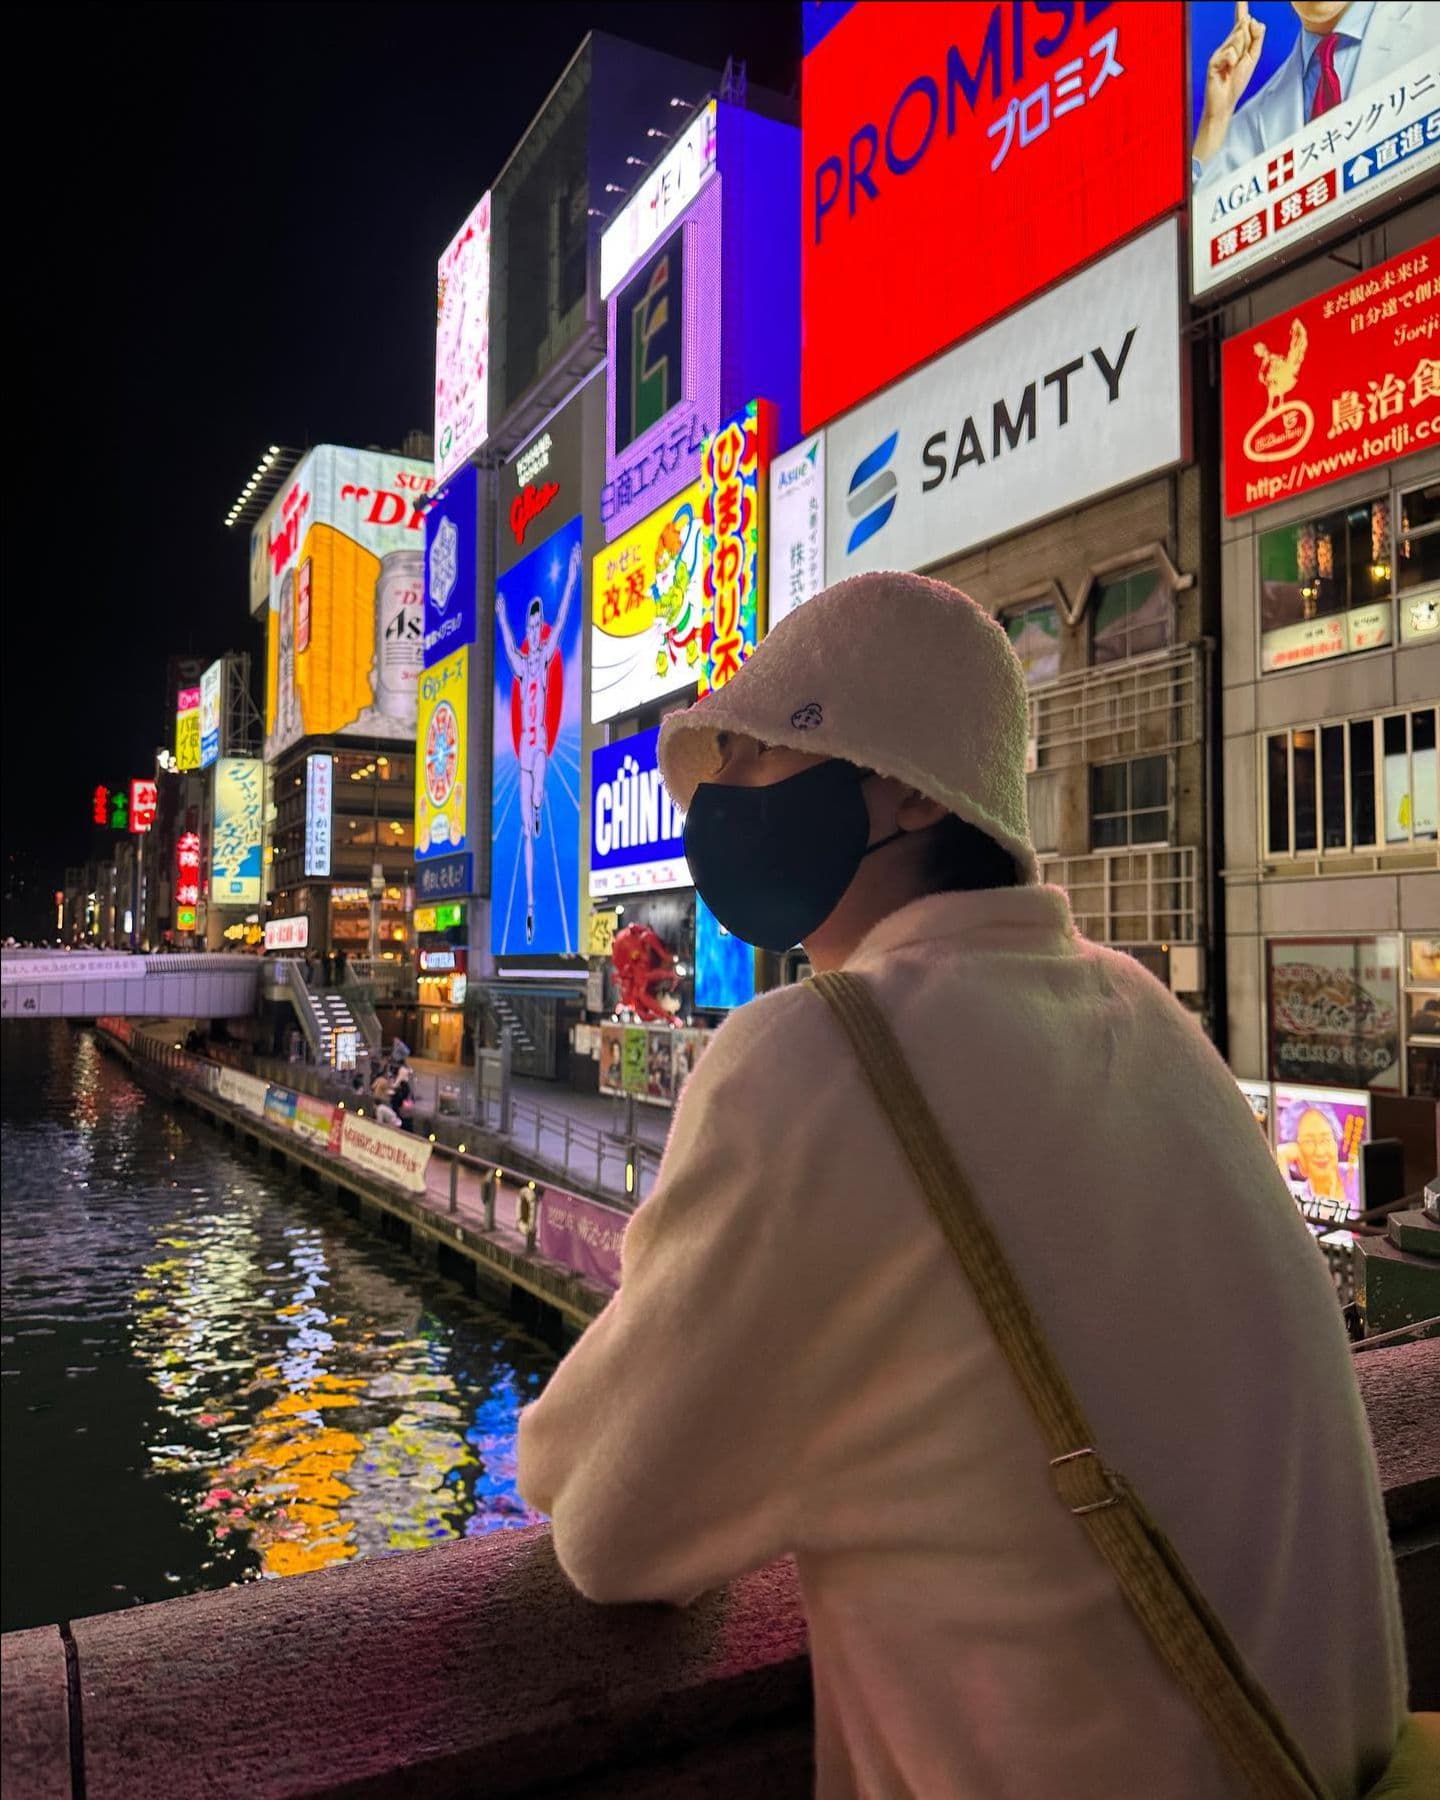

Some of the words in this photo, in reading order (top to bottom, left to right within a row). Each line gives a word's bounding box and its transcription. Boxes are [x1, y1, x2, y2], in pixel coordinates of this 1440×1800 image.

[815, 0, 1114, 246] PROMIS
[986, 26, 1125, 173] プロミス
[1210, 175, 1264, 224] AGA
[1299, 72, 1440, 171] スキンクリニ
[1216, 215, 1262, 260] 薄毛
[1279, 177, 1330, 225] 発毛
[601, 413, 708, 524] 日商エステム
[921, 324, 1140, 494] SAMTY
[509, 482, 560, 546] Glico
[602, 566, 646, 625] 改源
